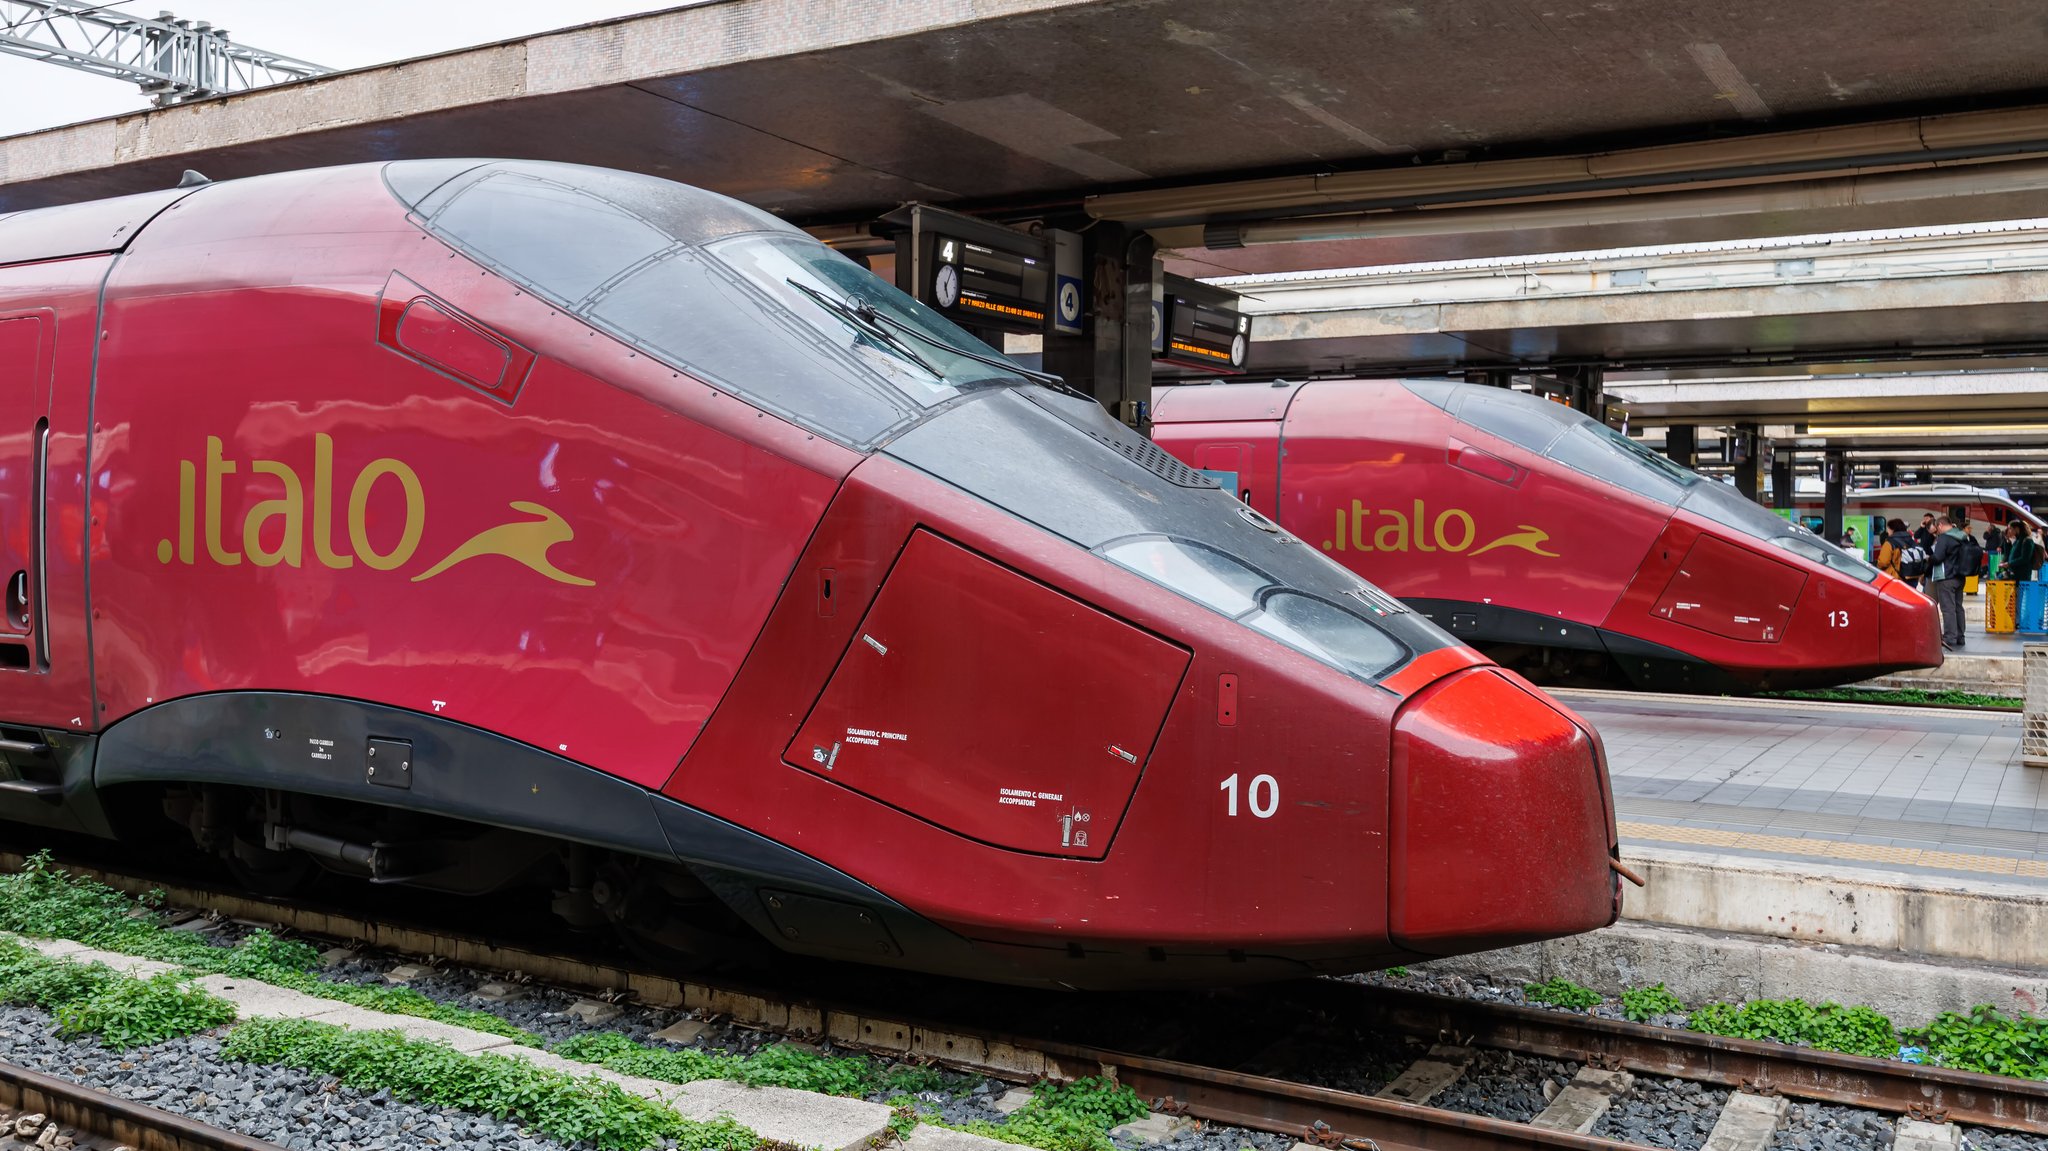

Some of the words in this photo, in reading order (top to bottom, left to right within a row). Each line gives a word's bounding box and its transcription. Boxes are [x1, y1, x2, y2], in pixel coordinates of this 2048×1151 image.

[942, 241, 953, 262] 4
[1065, 292, 1074, 312] 4
[1240, 316, 1247, 333] 5
[1828, 610, 1849, 628] 13
[846, 728, 875, 737] ISOLAMENTO
[881, 732, 907, 741] PRINCIPALE
[846, 736, 879, 746] ACCOPPIATORE
[999, 797, 1036, 807] ACCOPPIATORE
[1000, 788, 1031, 798] ISOLAMENTO
[1038, 792, 1063, 801] GENERALE
[1220, 773, 1280, 819] 10
